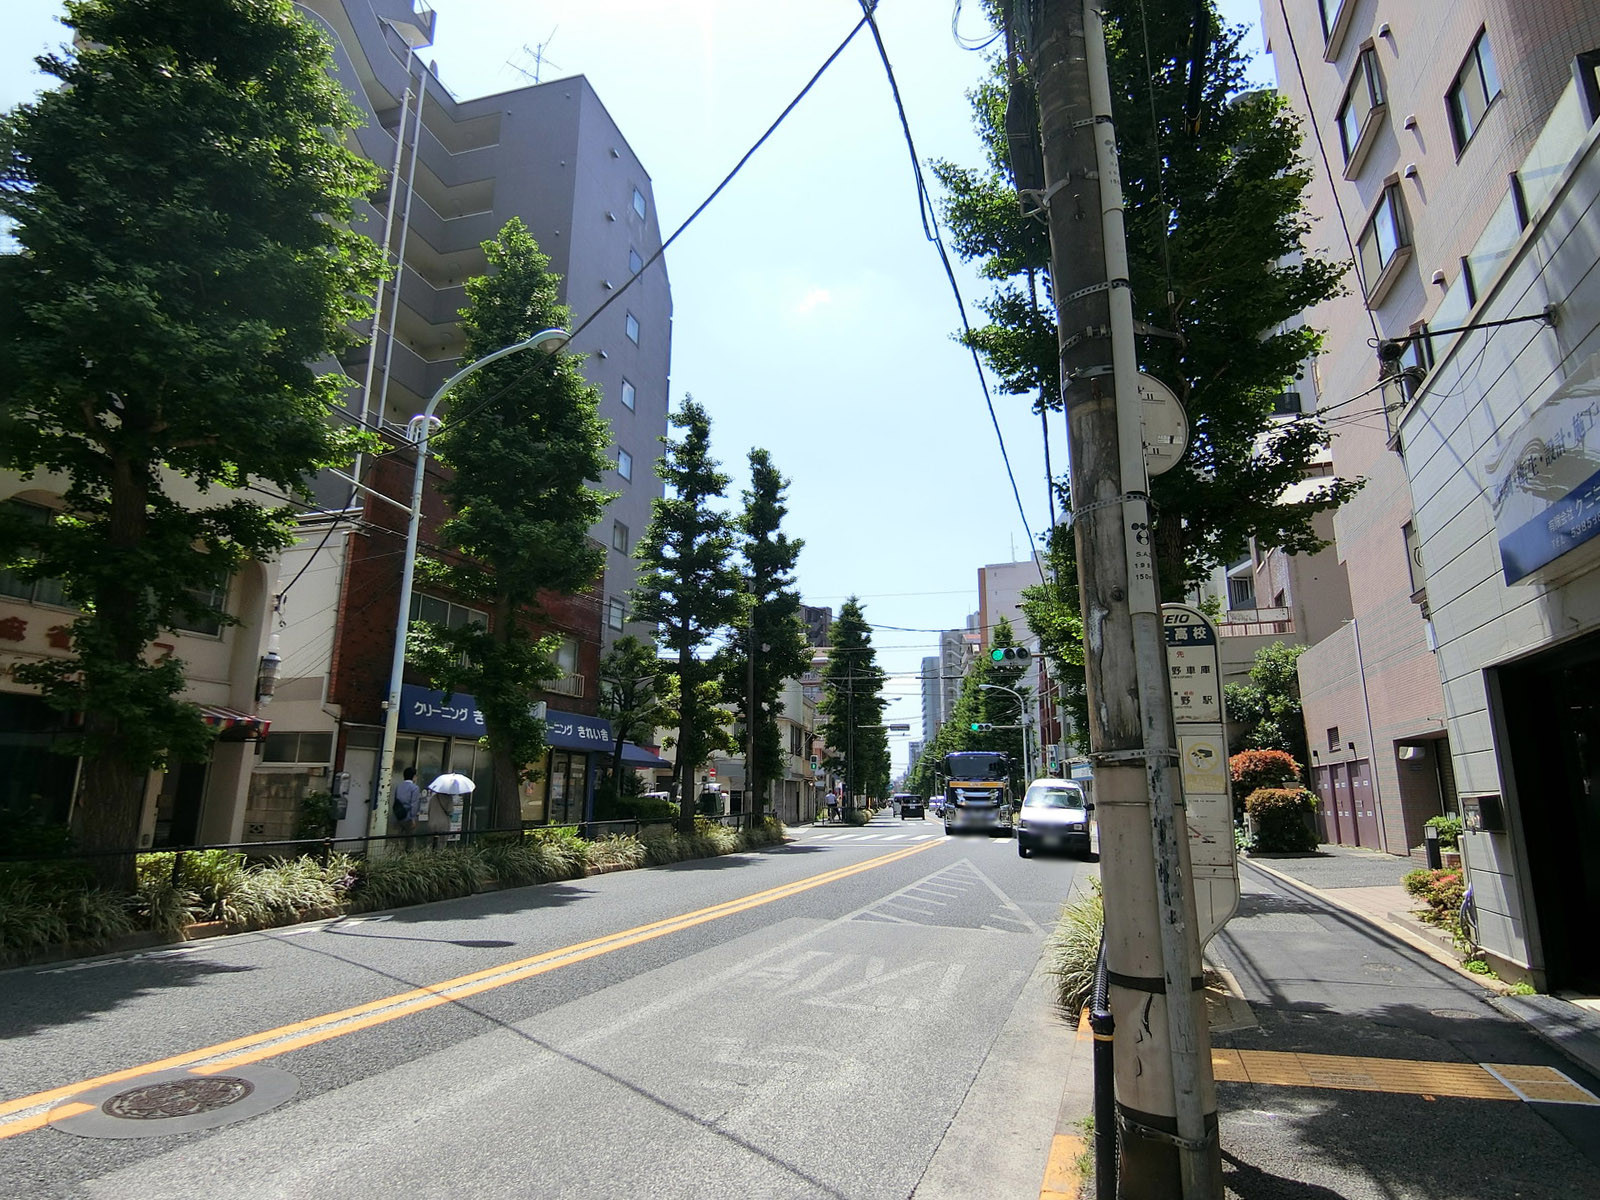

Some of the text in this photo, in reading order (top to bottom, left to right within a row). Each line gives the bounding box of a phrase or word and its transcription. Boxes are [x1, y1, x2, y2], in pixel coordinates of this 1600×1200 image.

[1162, 614, 1190, 624] EIO
[414, 701, 469, 721] クリーニング
